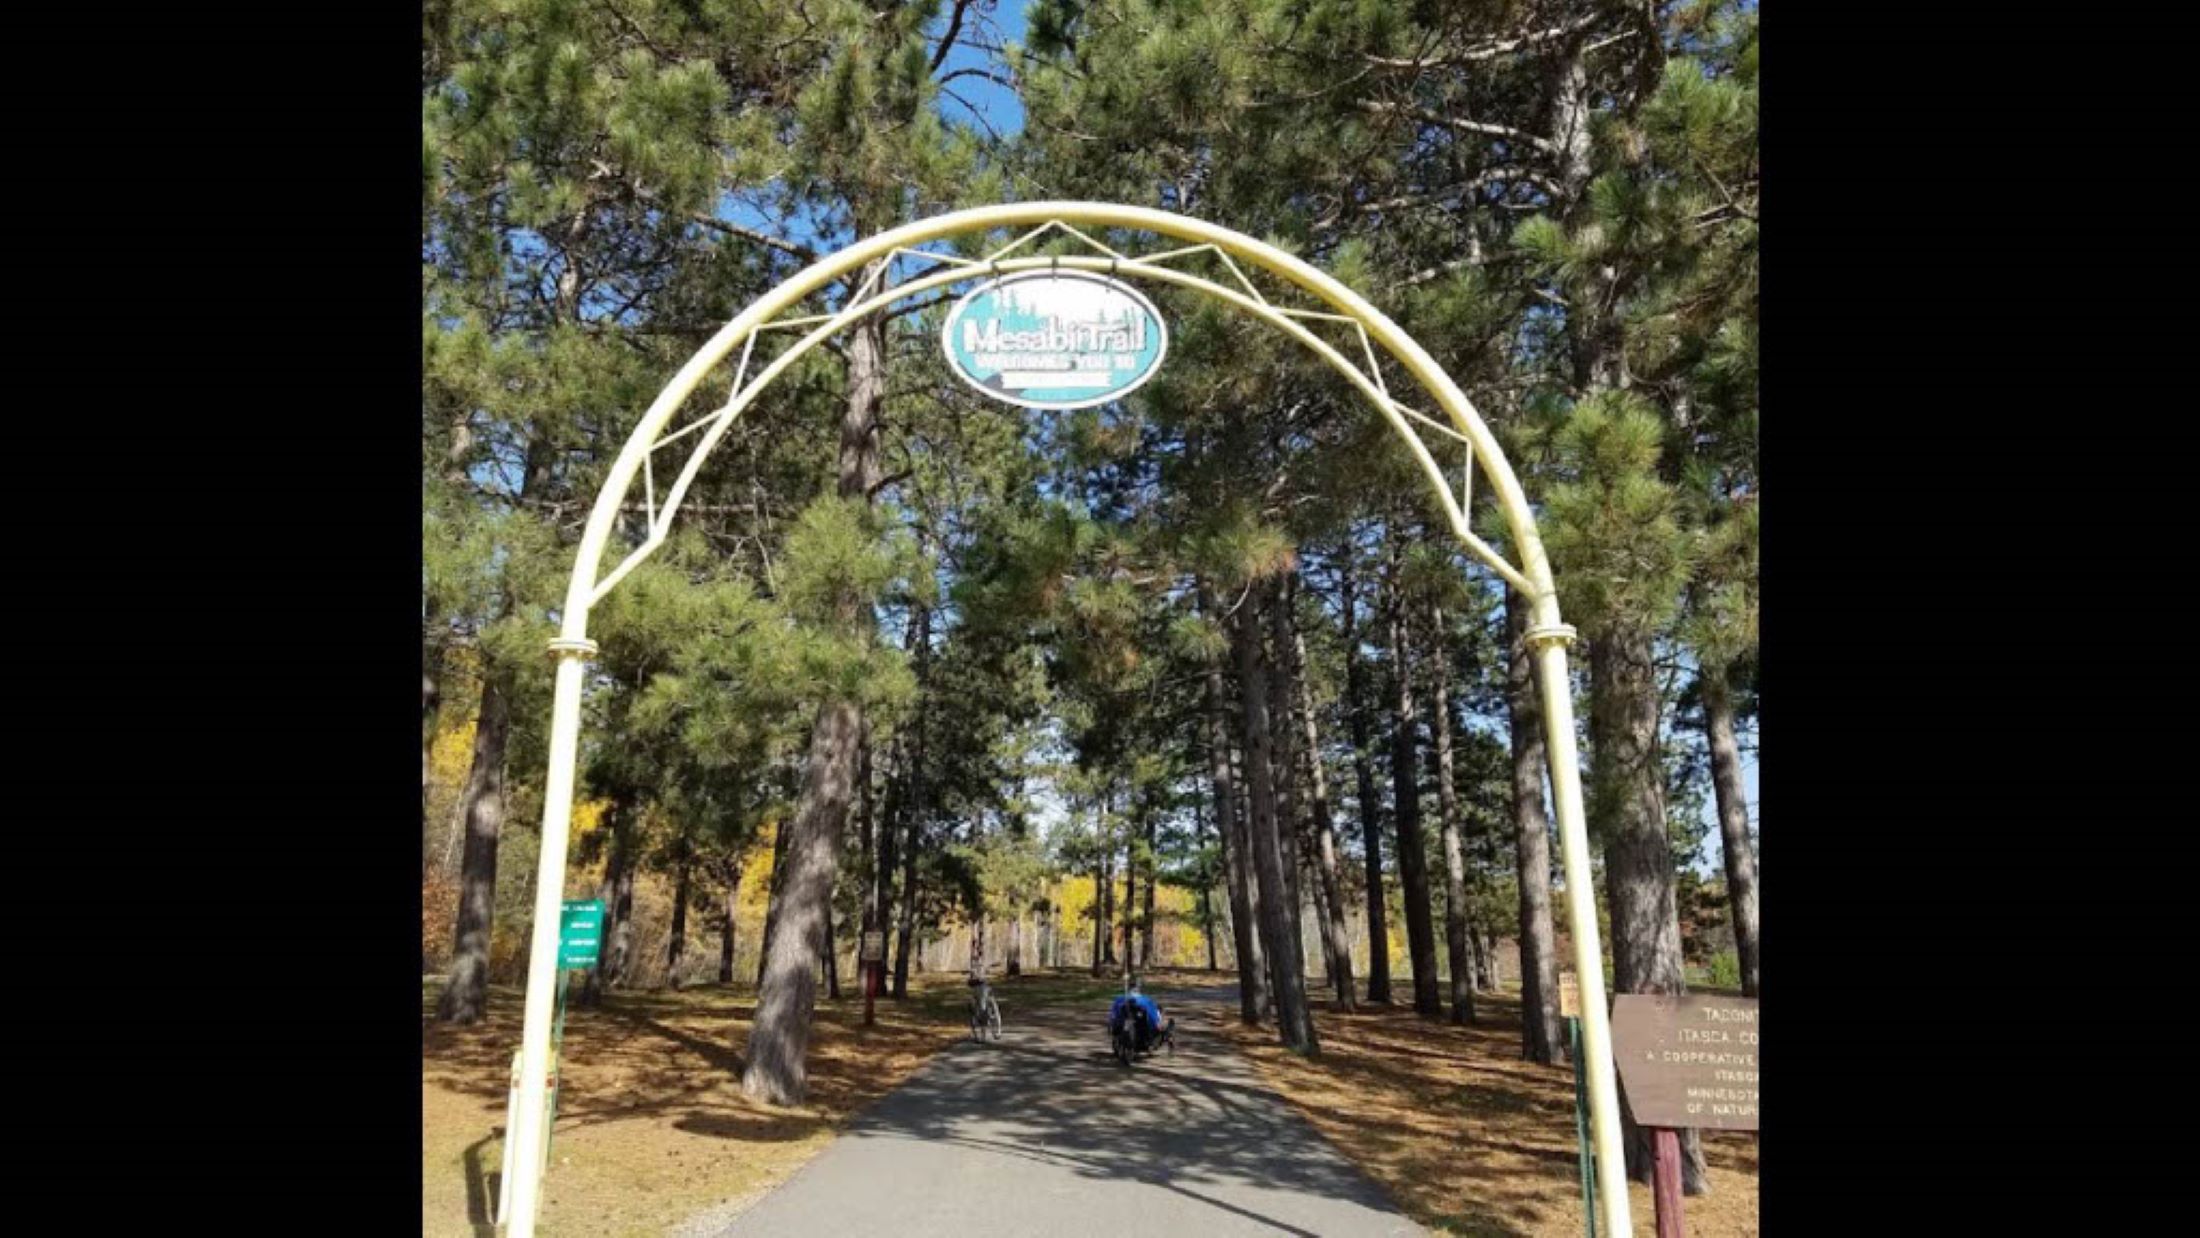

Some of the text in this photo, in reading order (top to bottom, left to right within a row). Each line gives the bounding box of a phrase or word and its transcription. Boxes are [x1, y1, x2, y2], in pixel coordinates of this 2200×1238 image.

[1702, 1007, 1759, 1024] TACONI
[1678, 1028, 1729, 1043] ITASCA
[1645, 1049, 1756, 1067] A COOPERATIVE
[1686, 1103, 1704, 1114] OF
